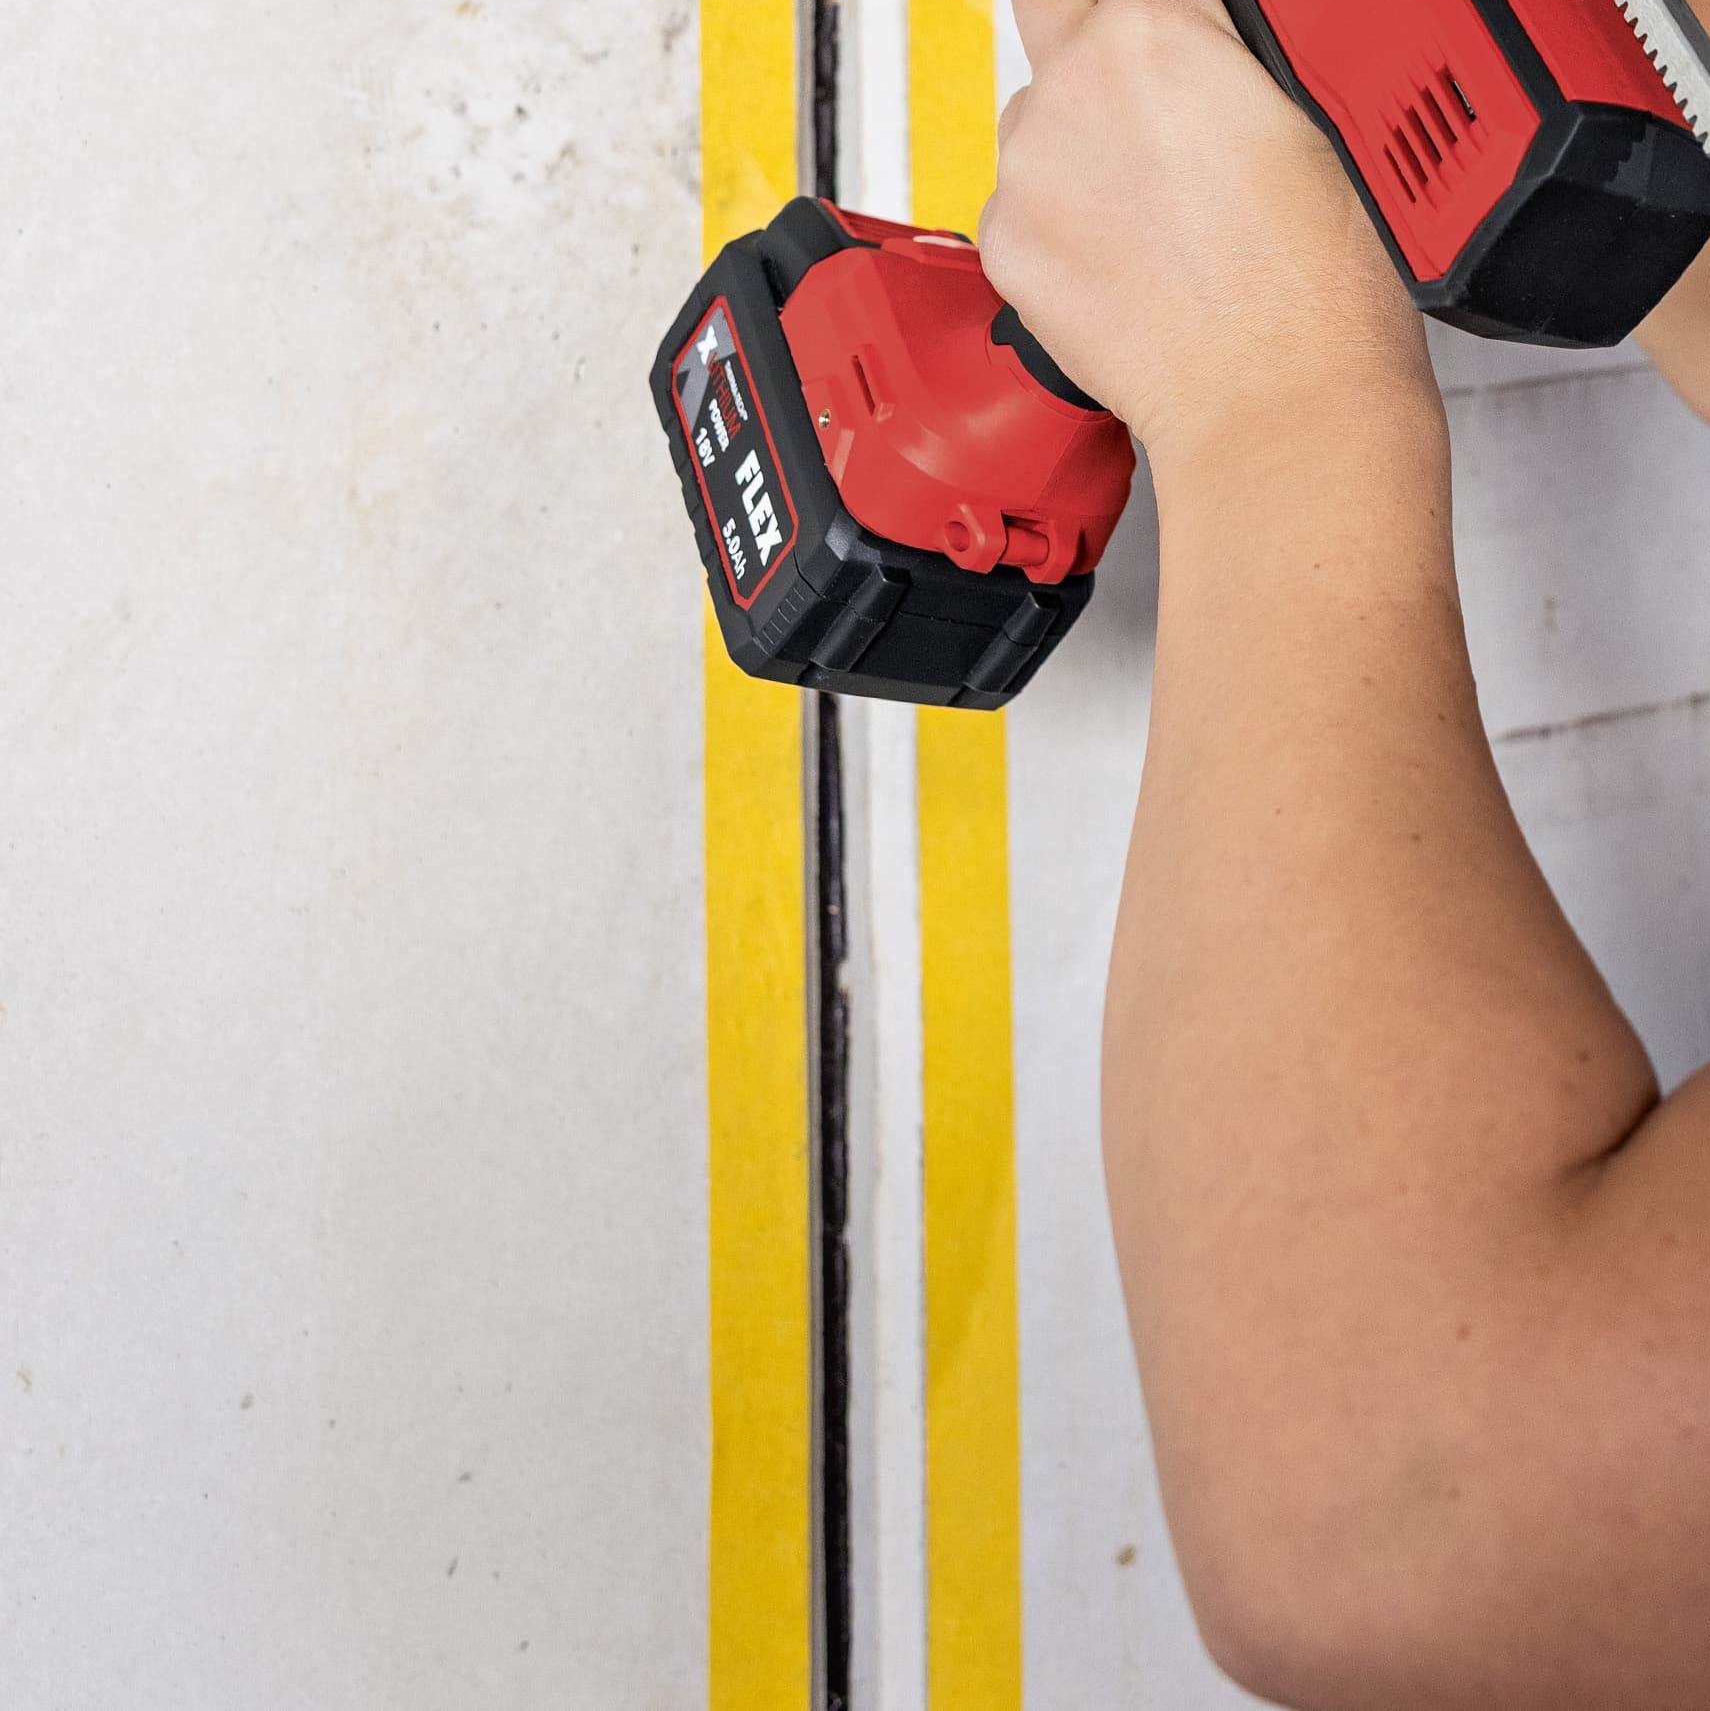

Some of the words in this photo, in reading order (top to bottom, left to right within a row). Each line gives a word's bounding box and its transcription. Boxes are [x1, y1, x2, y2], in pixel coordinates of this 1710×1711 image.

[707, 351, 741, 440] LITHIUM
[708, 398, 730, 452] POWER
[696, 427, 716, 467] 18V
[734, 449, 783, 567] FLEX
[722, 517, 747, 580] 5.0Ah
